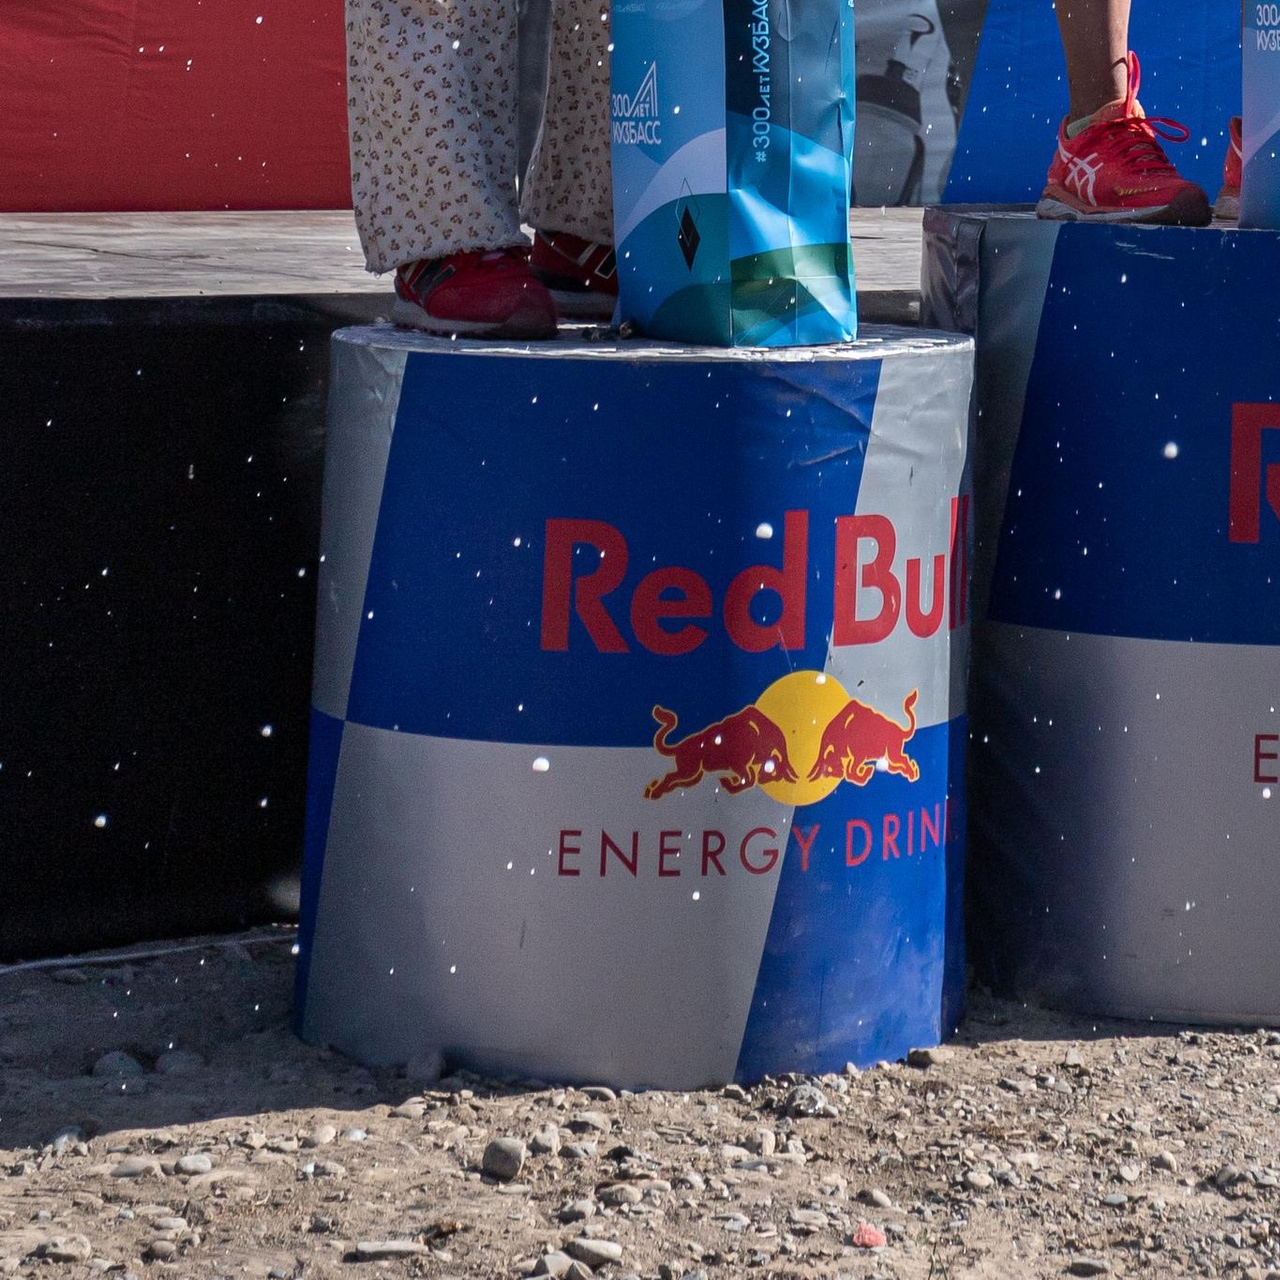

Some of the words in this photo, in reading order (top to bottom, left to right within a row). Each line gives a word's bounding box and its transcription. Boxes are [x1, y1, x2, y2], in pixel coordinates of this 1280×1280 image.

[538, 510, 809, 656] Red
[833, 494, 970, 647] Bull
[557, 822, 820, 879] ENERGY
